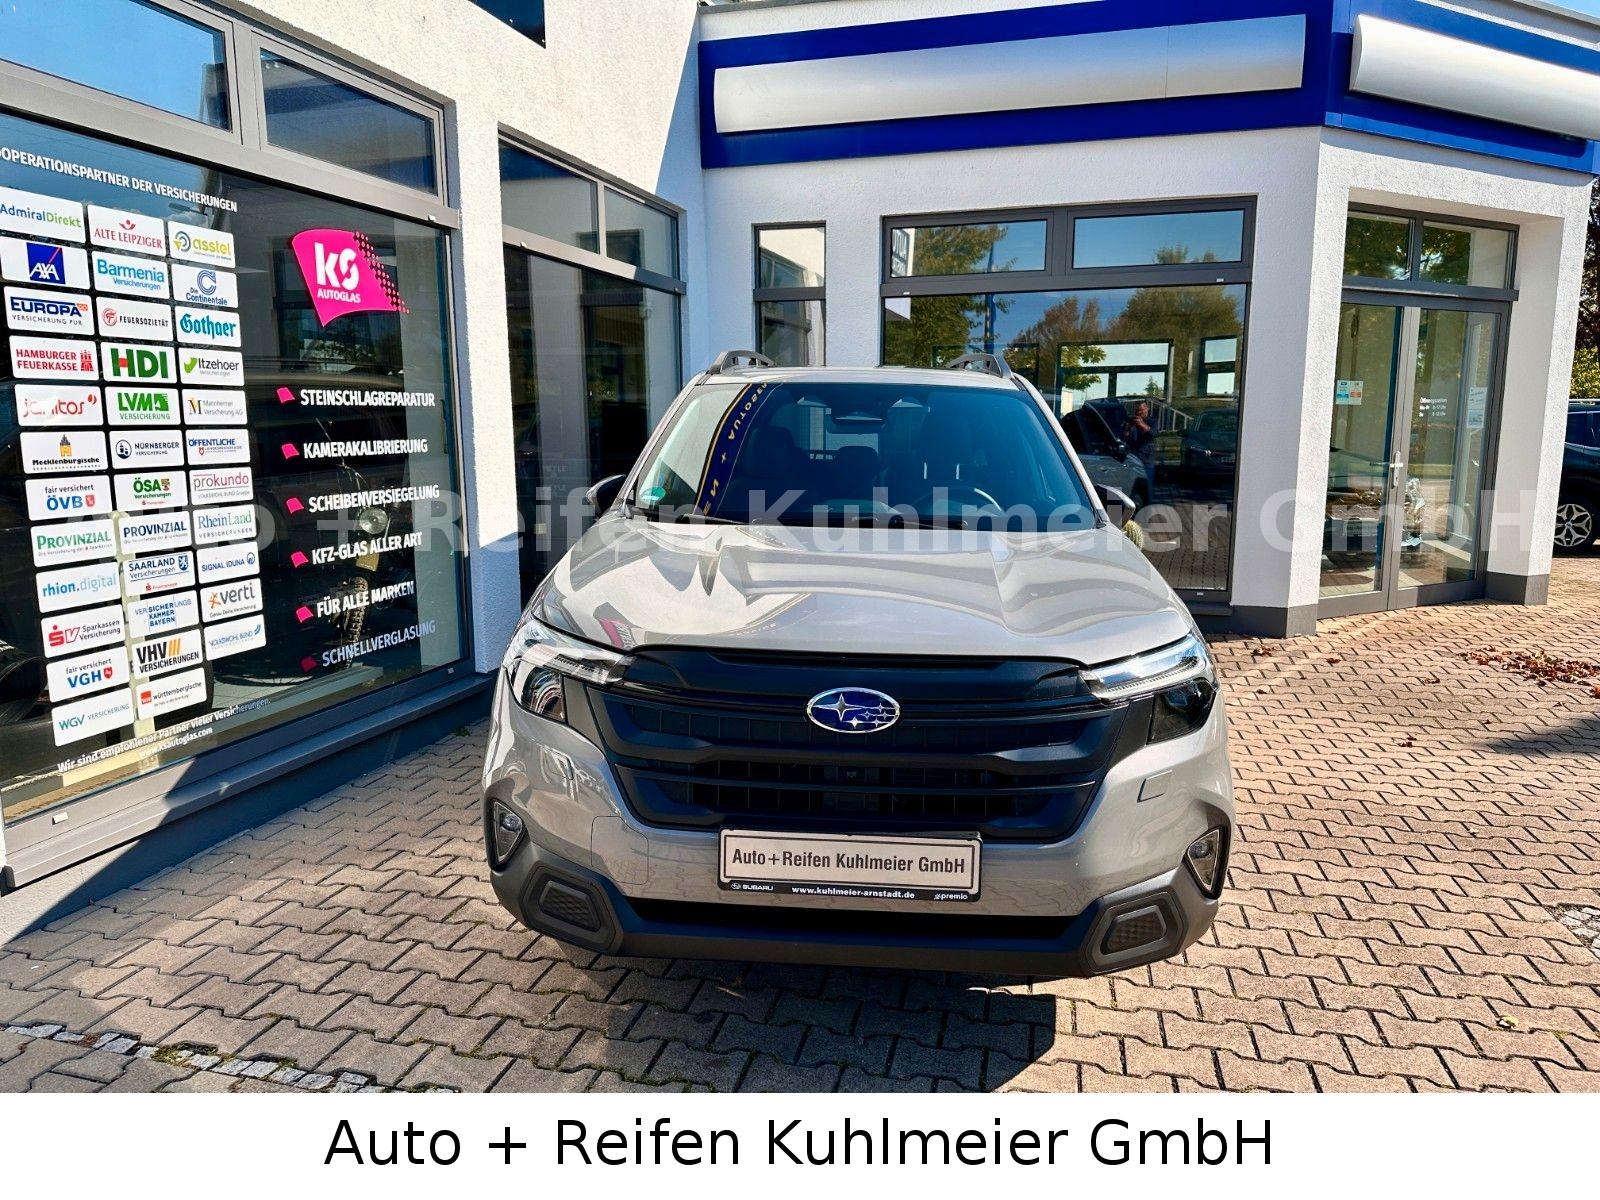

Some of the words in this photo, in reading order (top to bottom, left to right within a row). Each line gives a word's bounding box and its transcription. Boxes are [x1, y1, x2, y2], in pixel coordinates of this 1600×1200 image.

[0, 148, 130, 189] OPERATIONSPARTNER
[131, 176, 153, 193] DER
[154, 182, 238, 213] VERSICHERUNGEN
[0, 202, 82, 228] AdmiralDirekt
[94, 227, 117, 241] ALTE
[118, 231, 163, 250] LEIPZIGER
[192, 237, 231, 256] asstel
[29, 262, 60, 285] AXA
[97, 259, 165, 283] Barmenia
[113, 278, 161, 291] Versicherungen
[190, 287, 199, 295] Die
[186, 292, 228, 306] Continentale
[316, 287, 361, 304] AUTOGLAS
[10, 296, 82, 317] EUROPA
[12, 314, 67, 326] VERSICHERUNG
[120, 315, 169, 328] FEUERSOZIETÄT
[180, 312, 237, 340] Gothaer
[16, 348, 77, 361] HAMBURGER
[110, 347, 169, 379] HDI
[17, 360, 78, 372] FEUERKASSE
[198, 358, 240, 371] Itzehoer
[118, 392, 153, 412] LVM
[300, 389, 436, 407] STEINSCHLAGREPARATUR
[120, 412, 171, 420] VERSICHERUNG
[134, 441, 180, 450] NÜRNBERGER
[188, 438, 236, 447] ÖFFENTLICHE
[303, 438, 428, 459] KAMERAKALIBRIERUNG
[32, 456, 100, 467] Mecklenburgische
[133, 477, 161, 493] ÖSA
[193, 471, 249, 489] prokundo
[44, 485, 58, 495] fair
[59, 484, 94, 493] versichert
[308, 484, 440, 513] SCHEIBENVERSIEGELUNG
[46, 495, 83, 511] ÖVB
[123, 520, 187, 537] PROVINZIAL
[198, 511, 252, 529] RheinLand
[36, 530, 112, 549] PROVINZIAL
[199, 527, 253, 539] VERSICHERUNGEN
[311, 541, 369, 565] KFZ-GLAS
[370, 534, 403, 555] ALLER
[403, 531, 423, 548] ART
[128, 557, 176, 571] SAARLAND
[129, 566, 176, 580] Versicherungen
[201, 562, 225, 572] SIGNAL
[226, 558, 245, 568] IDUNA
[42, 574, 117, 597] rhion.digital
[220, 582, 256, 604] verti
[316, 595, 341, 618] FÜR
[342, 589, 370, 611] ALLE
[371, 580, 415, 602] MARKEN
[149, 610, 175, 620] KAMMER
[149, 616, 176, 627] BAYERN
[79, 626, 121, 641] Versicherung
[82, 619, 120, 633] Sparkassen
[135, 640, 168, 662] VHV
[322, 620, 436, 667] SCHNELLVERGLASUNG
[65, 665, 79, 675] fair
[79, 658, 112, 671] versichert
[139, 650, 200, 674] VERSICHERUNGEN
[67, 672, 103, 689] VGH
[153, 681, 202, 700] württembergische
[87, 703, 130, 721] VERSICHERUNG
[58, 713, 86, 731] WGV
[57, 759, 75, 773] Wir
[77, 751, 98, 767] sind
[99, 736, 157, 760] empfohlener
[159, 723, 191, 742] Partner
[191, 714, 214, 729] vieler
[140, 726, 213, 758] www.ksautoglas.com
[836, 853, 914, 872] Kuhlmeier
[918, 856, 965, 873] GmbH
[791, 886, 916, 900] www.kuhlmeier-arnstadt.de
